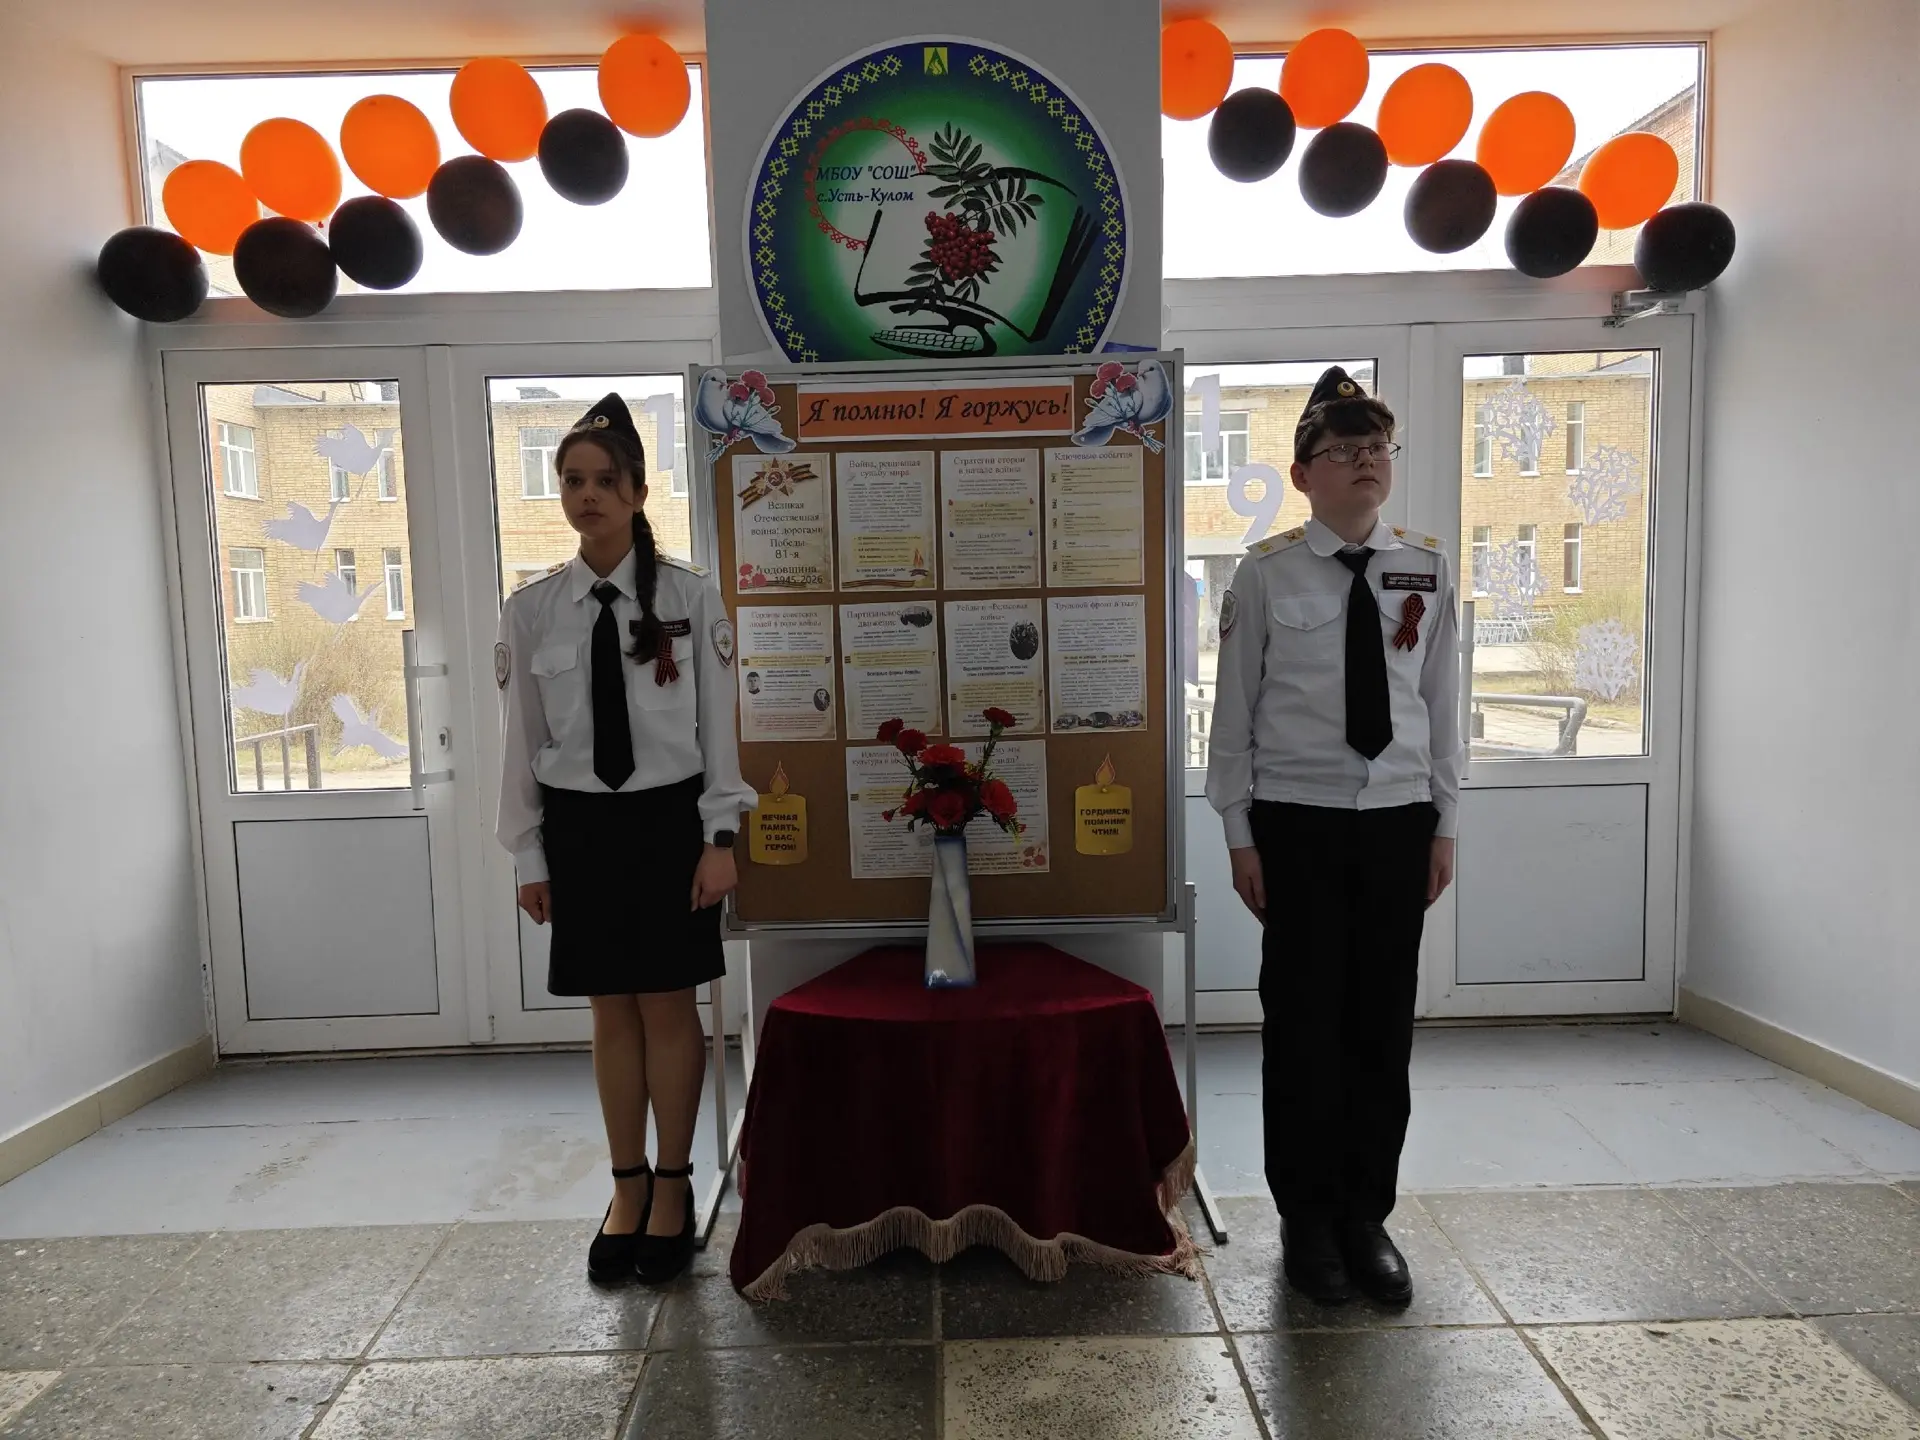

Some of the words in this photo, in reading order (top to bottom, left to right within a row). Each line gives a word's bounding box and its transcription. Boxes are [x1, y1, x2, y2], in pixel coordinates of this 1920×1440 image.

[816, 166, 863, 181] МБОУ
[867, 165, 917, 180] "СОШ"
[817, 188, 914, 206] с.Усть-Кулом
[800, 398, 829, 427] Я
[832, 398, 926, 422] помню!
[934, 394, 959, 421] Я
[960, 392, 1070, 426] горжусь!
[768, 501, 805, 510] Великая
[754, 514, 820, 523] Отечественная
[775, 549, 800, 559] 81-я
[760, 824, 800, 832] ПАМЯТЬ,
